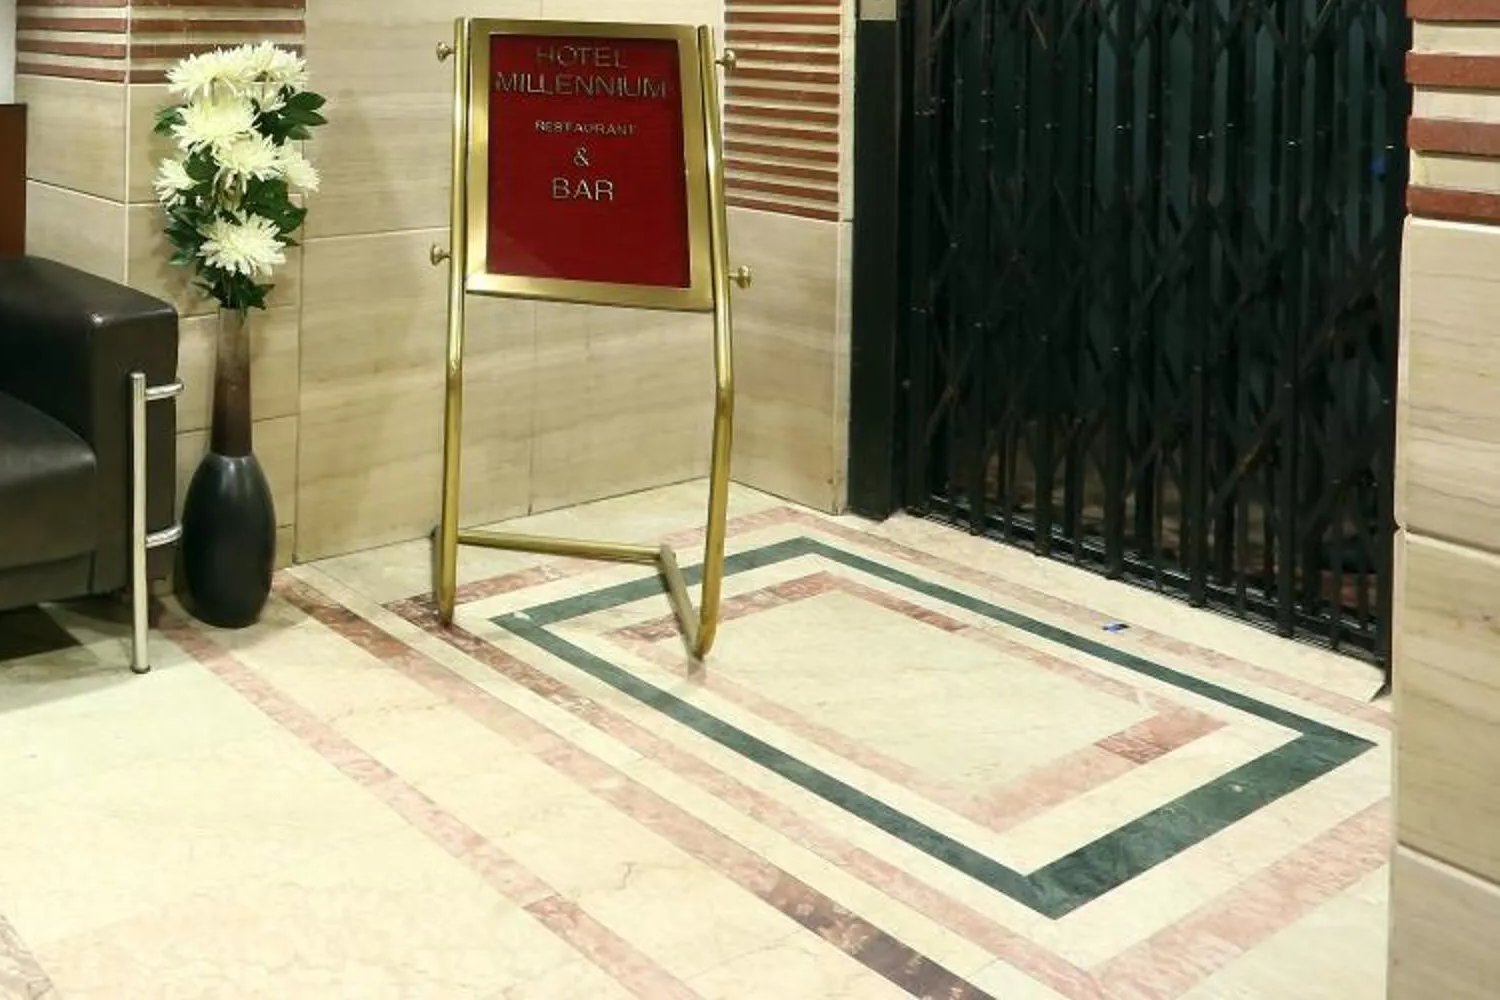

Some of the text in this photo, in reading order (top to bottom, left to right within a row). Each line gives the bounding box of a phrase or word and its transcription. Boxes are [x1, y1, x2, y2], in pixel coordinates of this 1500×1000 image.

[536, 45, 628, 69] HOTEL
[495, 71, 667, 99] MILLENNIUM
[535, 120, 636, 137] RESTAURANT
[573, 146, 590, 167] &
[552, 177, 613, 201] BAR
